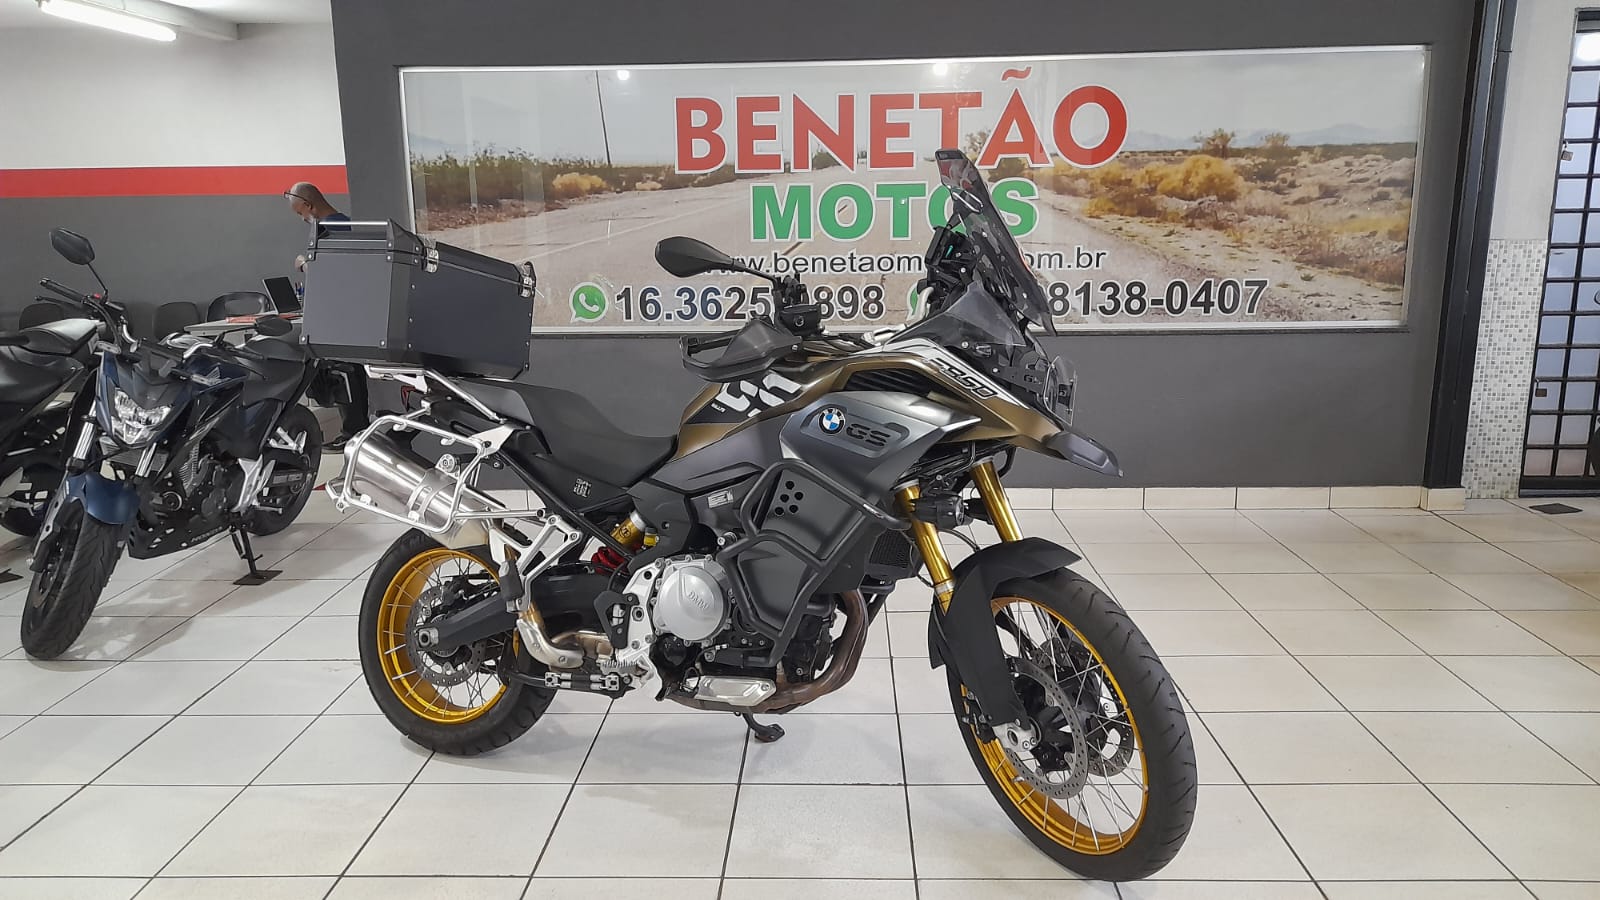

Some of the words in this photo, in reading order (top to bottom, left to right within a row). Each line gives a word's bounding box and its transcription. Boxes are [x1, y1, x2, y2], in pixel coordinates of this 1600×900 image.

[675, 66, 1128, 172] BENETÃO
[615, 285, 885, 322] 16.3625898
[1049, 279, 1269, 317] 8138-0407
[846, 423, 891, 447] GS
